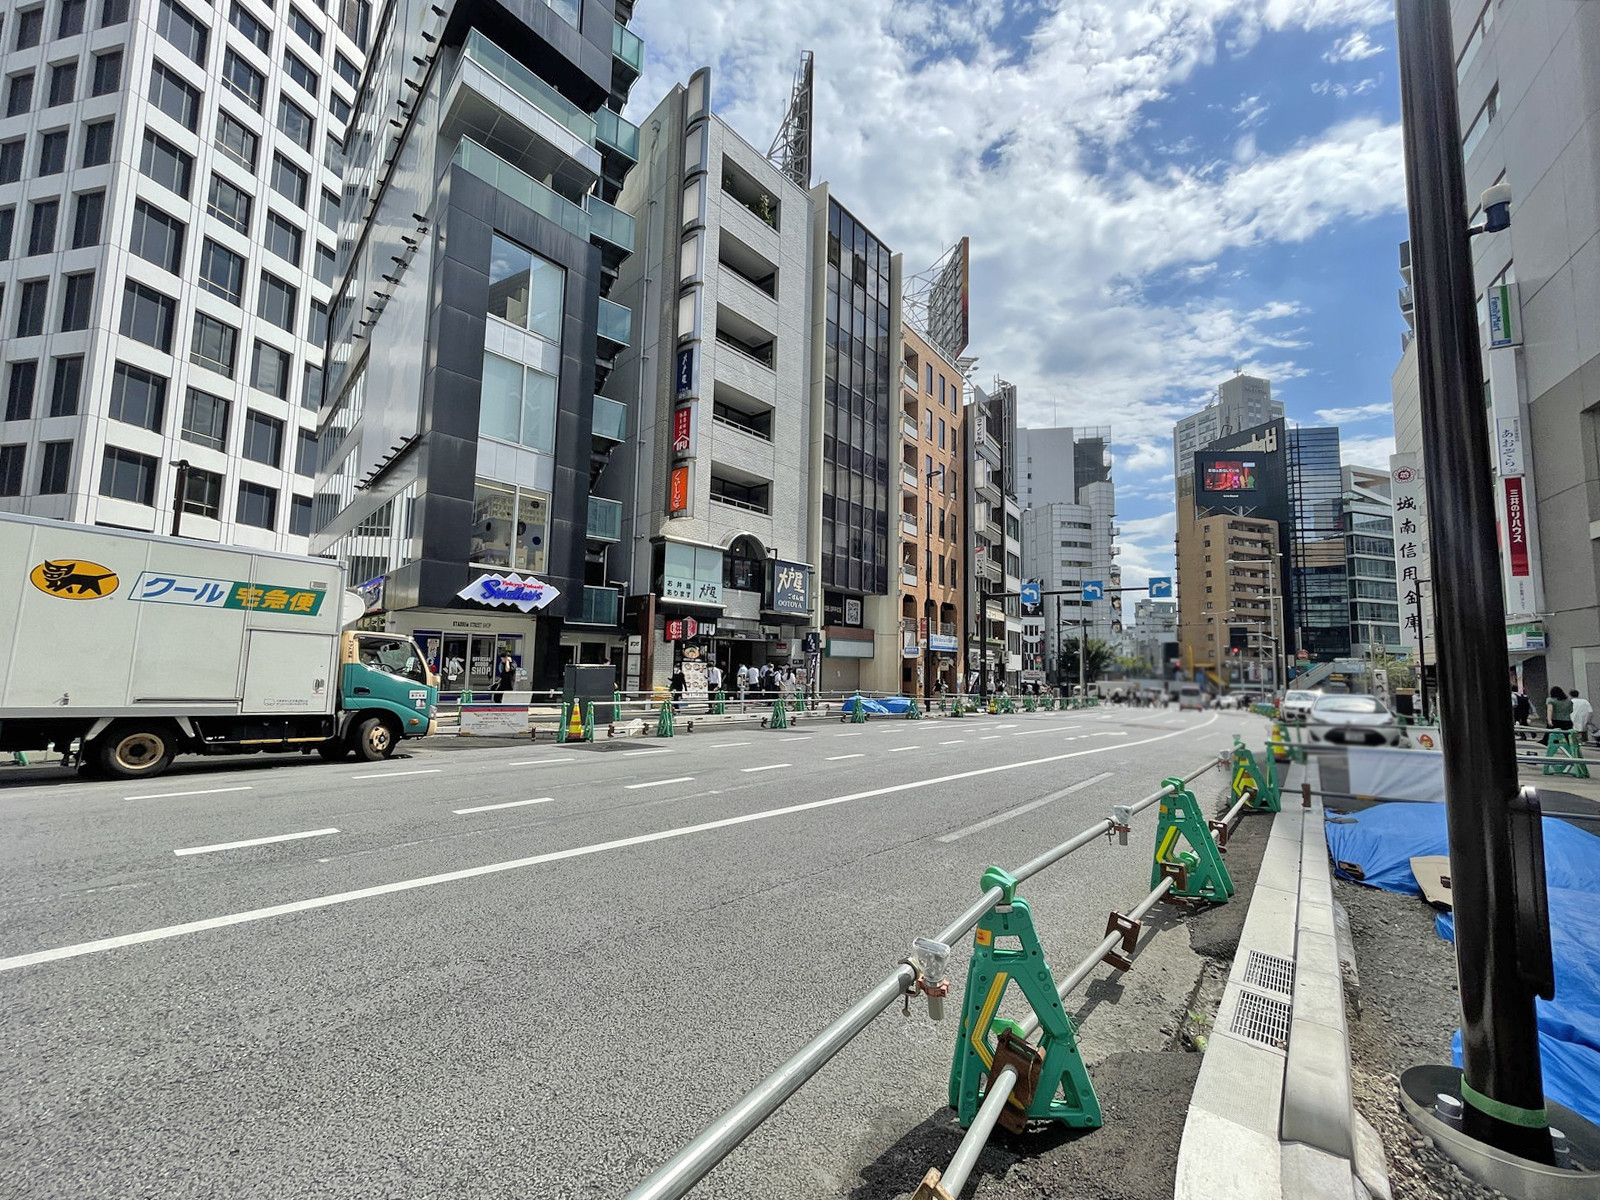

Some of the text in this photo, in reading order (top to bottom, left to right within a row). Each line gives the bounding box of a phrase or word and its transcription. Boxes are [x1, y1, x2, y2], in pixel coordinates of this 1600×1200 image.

[1490, 296, 1502, 332] FamilyMart
[1509, 488, 1523, 543] 三井のリハウス
[1396, 496, 1422, 634] 城南信用金庫
[480, 579, 543, 601] Swallows
[698, 583, 718, 599] 大戸屋
[777, 567, 805, 594] 大戸屋
[141, 577, 318, 613] クール宅急便
[666, 589, 691, 598] あります
[778, 600, 803, 609] OOTOYA
[699, 622, 716, 635] IFU
[471, 666, 491, 675] SHOP
